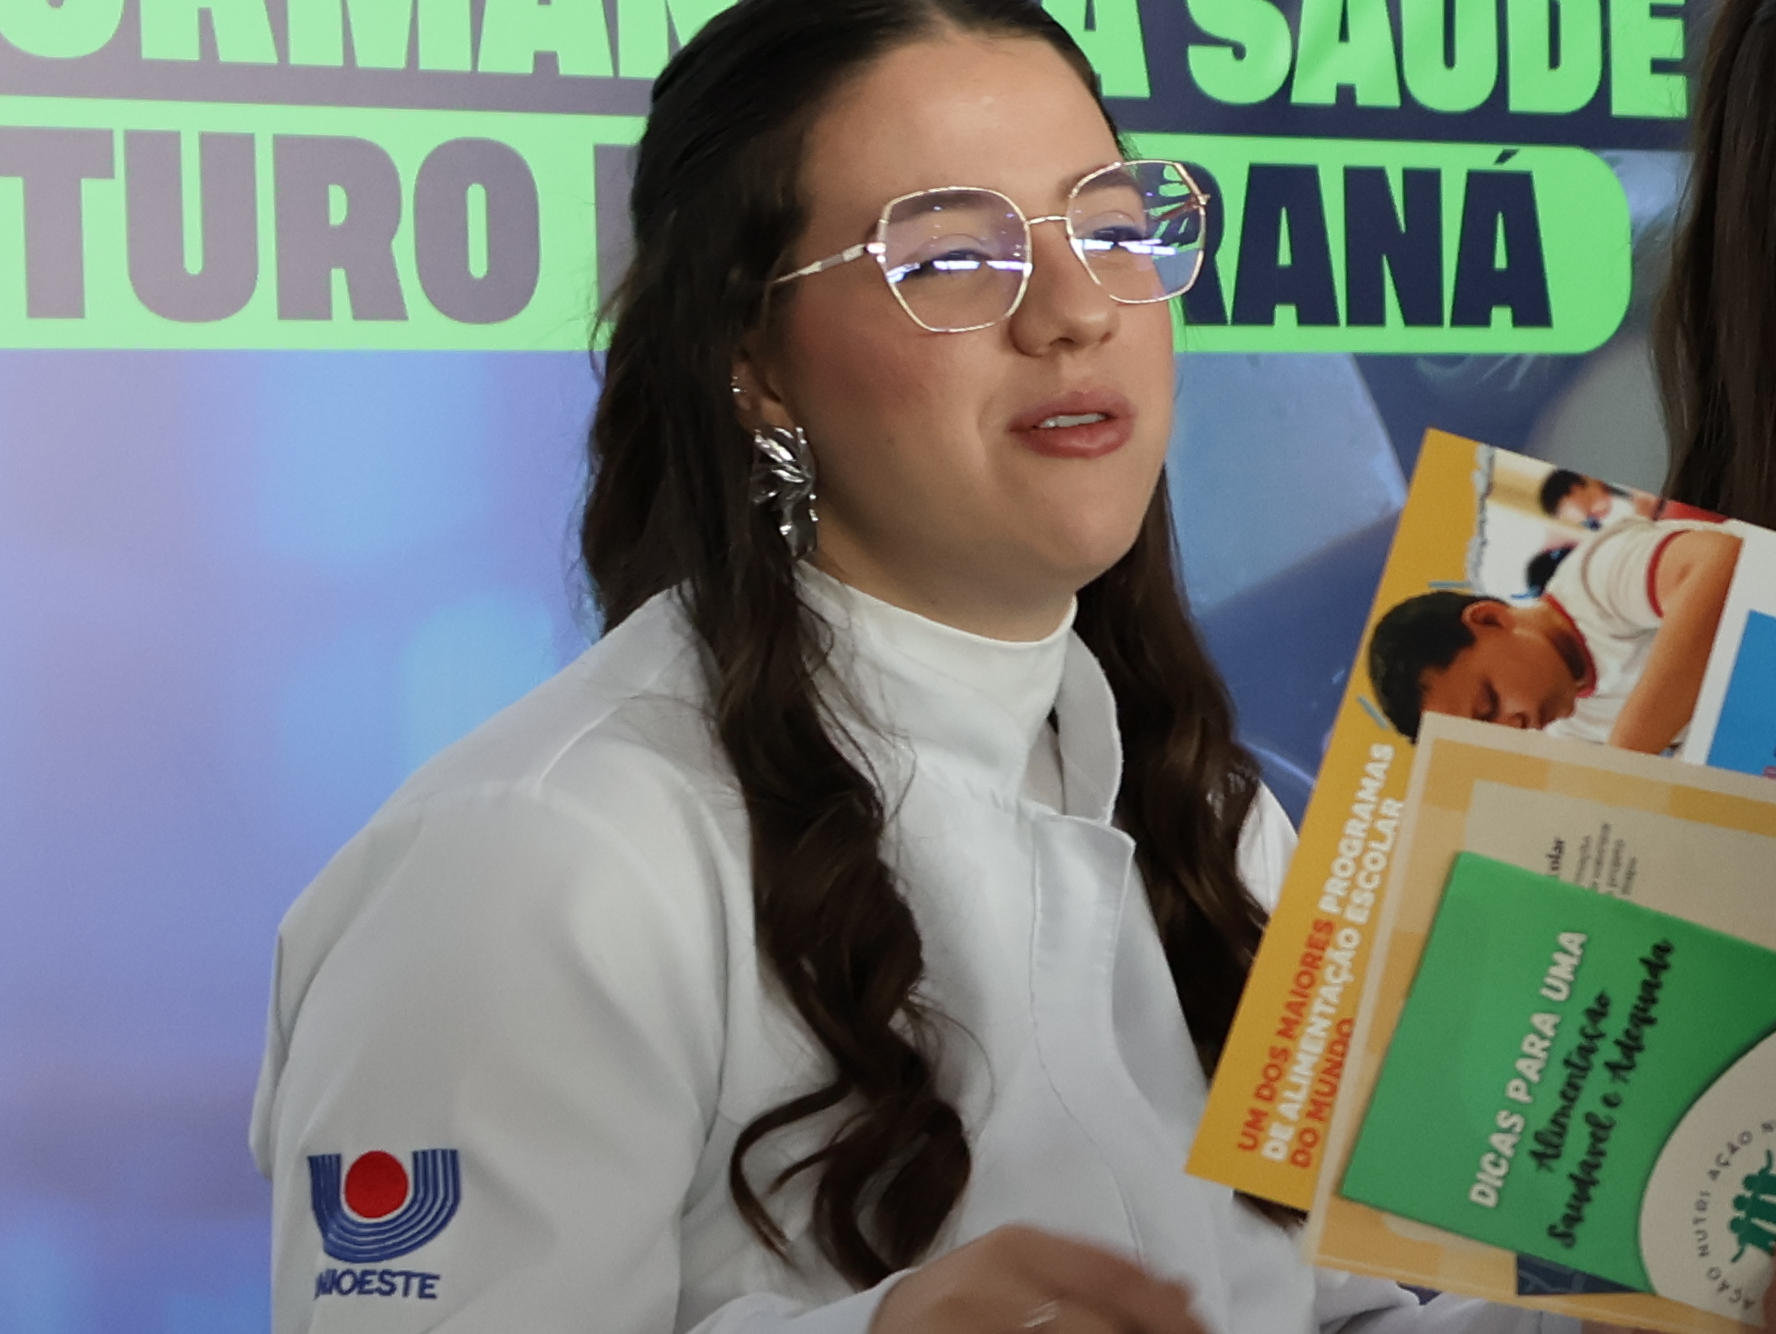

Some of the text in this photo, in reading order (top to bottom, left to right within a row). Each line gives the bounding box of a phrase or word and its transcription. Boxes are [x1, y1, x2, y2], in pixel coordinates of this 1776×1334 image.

[0, 124, 542, 326] TURO
[1237, 743, 1393, 1151] UM DOS MAIORES PROGRAMAS
[1263, 797, 1404, 1164] DE ALIMENTAÇÃO ESCOLAR
[1604, 939, 1674, 1082] Adequada
[1290, 1013, 1357, 1168] DO MUNDO
[1469, 1109, 1524, 1207] DICAS
[1506, 1012, 1559, 1103] PARA
[1540, 931, 1585, 1001] UMA
[1601, 1093, 1622, 1109] e
[1693, 1191, 1711, 1257] NUTRI
[1708, 1131, 1753, 1181] AÇÃO
